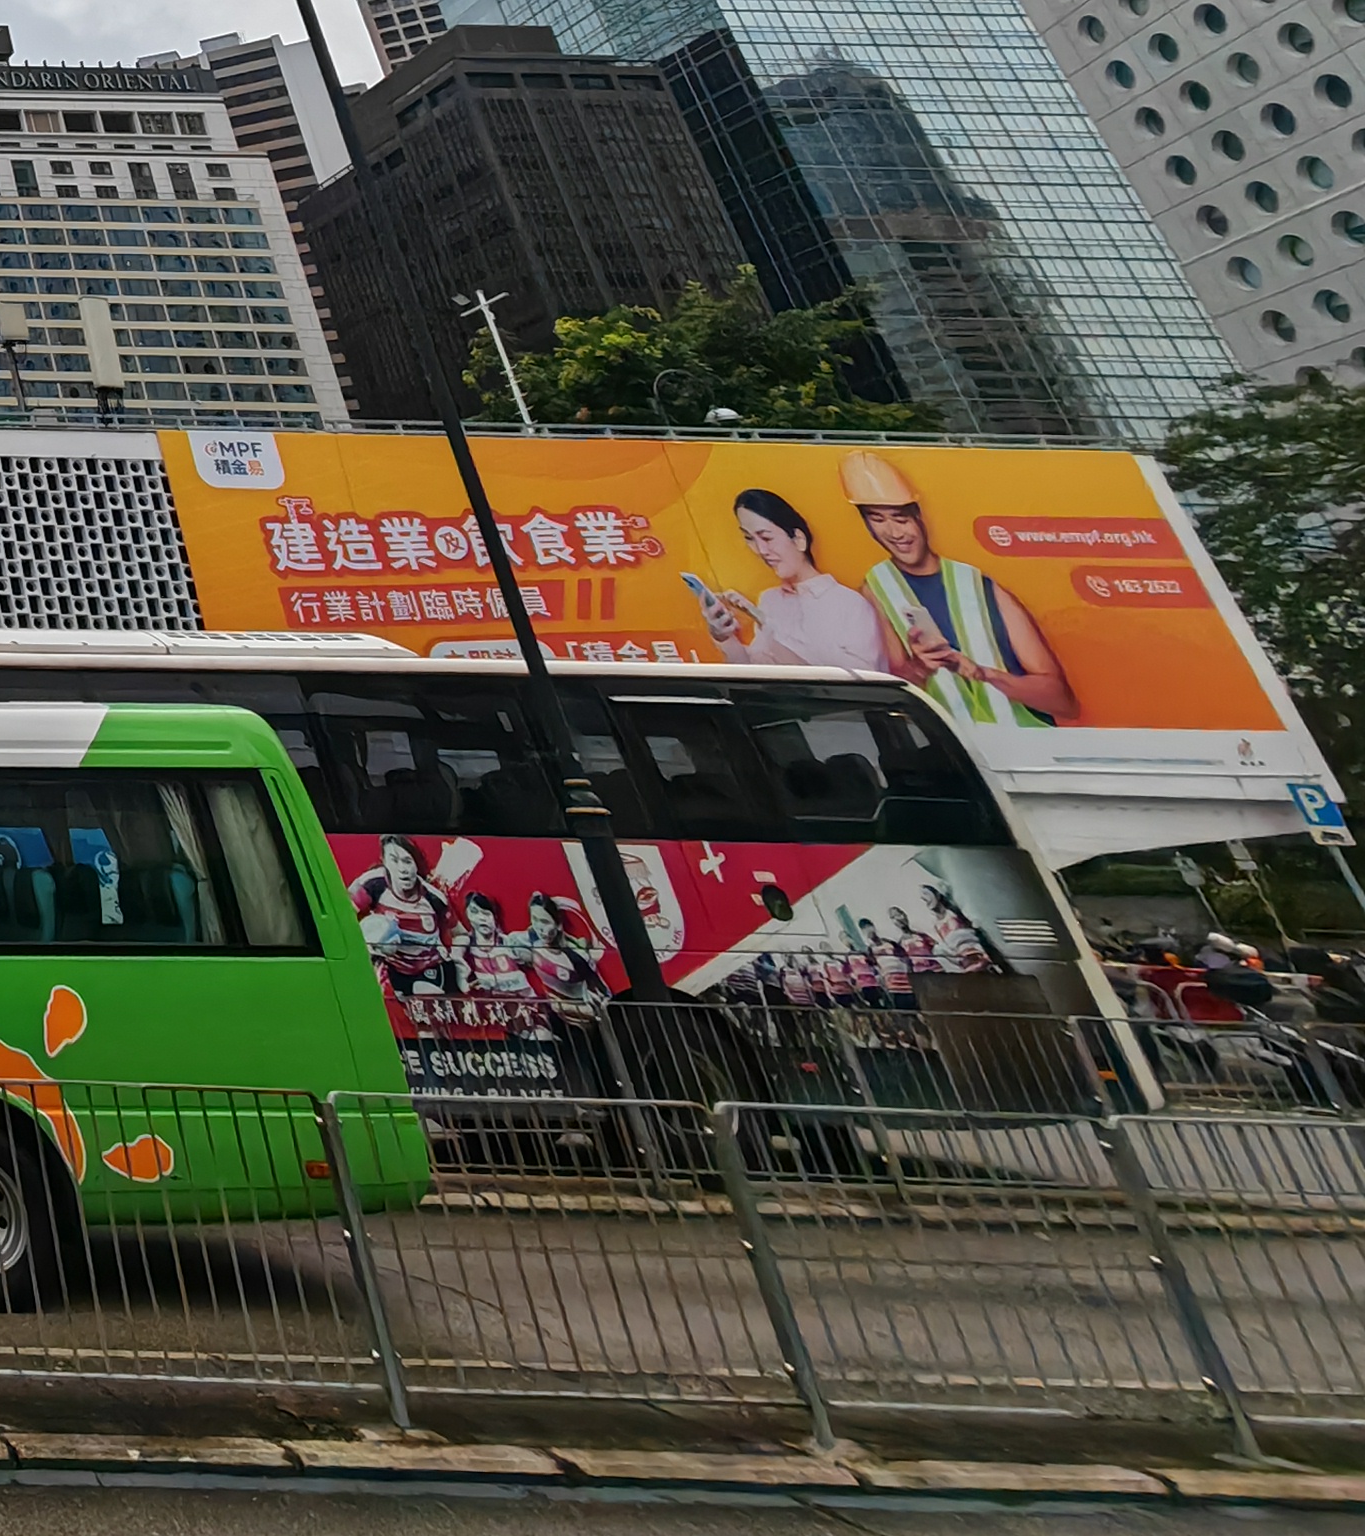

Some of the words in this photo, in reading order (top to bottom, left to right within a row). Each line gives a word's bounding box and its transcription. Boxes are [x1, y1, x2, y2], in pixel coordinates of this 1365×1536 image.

[83, 72, 197, 92] ORIENTAL
[213, 458, 265, 476] 積金易
[1296, 787, 1327, 823] P
[429, 1050, 558, 1080] SUCCESS
